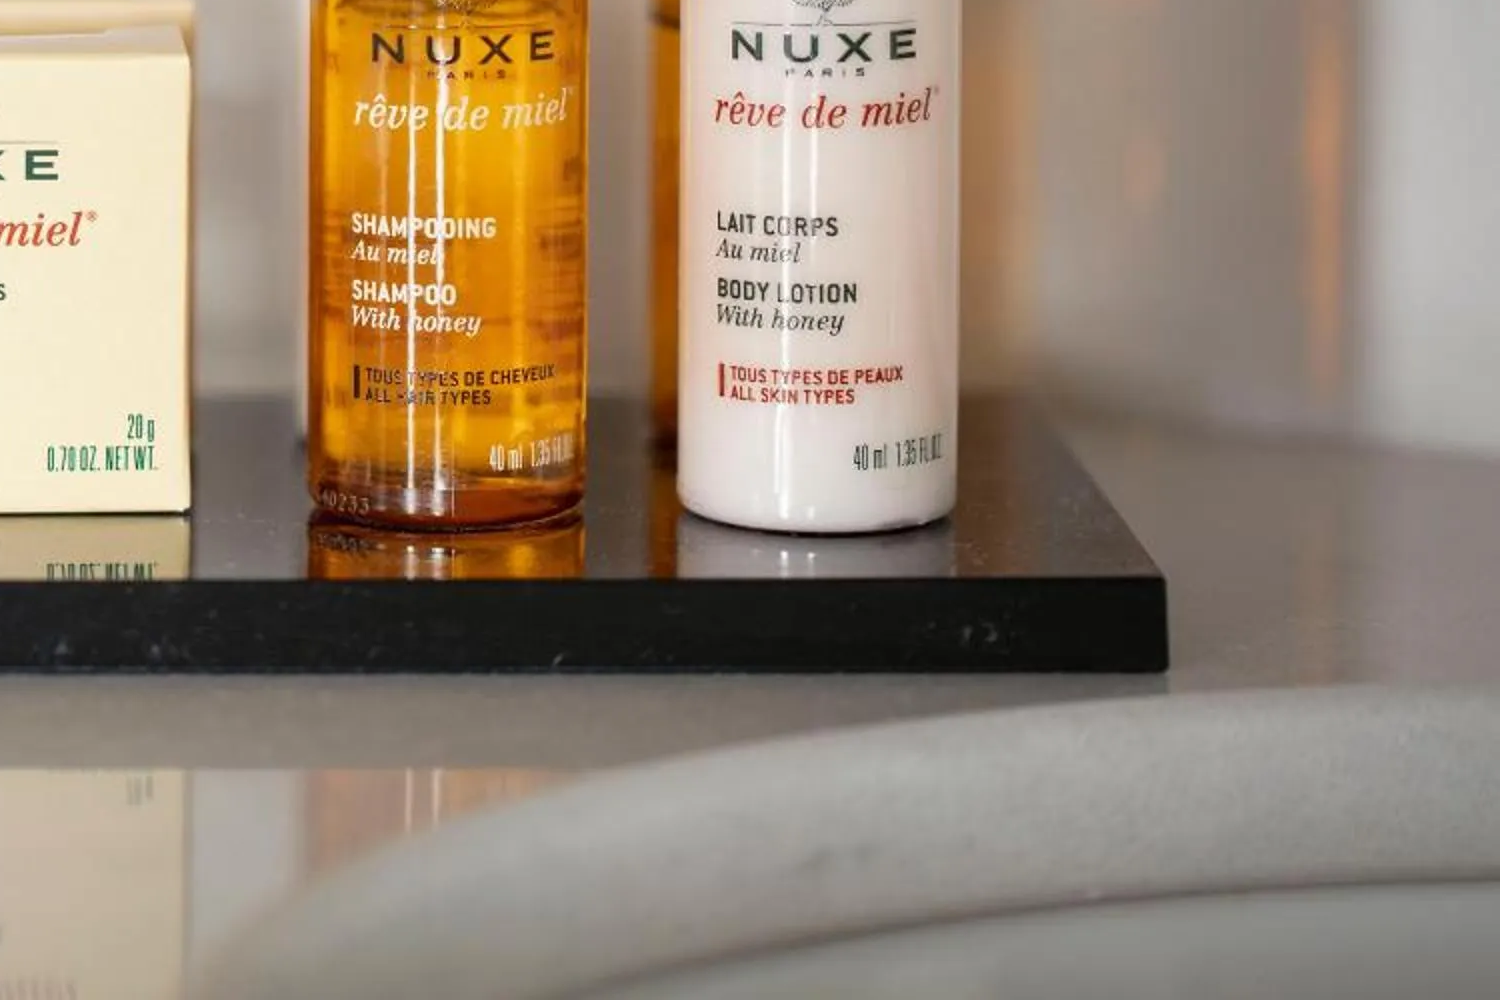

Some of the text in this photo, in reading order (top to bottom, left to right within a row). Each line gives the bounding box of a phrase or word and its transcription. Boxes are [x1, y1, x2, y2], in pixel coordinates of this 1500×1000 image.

[372, 30, 554, 65] NUXE
[731, 28, 917, 63] NUXE
[786, 68, 865, 77] PARIS
[354, 94, 428, 130] rêve
[444, 96, 490, 131] de
[715, 91, 786, 129] rêve
[801, 96, 847, 129] de
[351, 212, 497, 239] SHAMPOOING
[717, 210, 839, 237] LAIT CORPS
[350, 239, 440, 265] Au miel
[716, 238, 801, 263] Au miel
[352, 279, 457, 306] SHAMPOO
[717, 278, 857, 304] BODY LOTION
[351, 305, 481, 337] With honey
[716, 304, 845, 337] With honey
[366, 364, 555, 387] TOUS TYPES DE CHEVEUX
[730, 365, 904, 385] TOUS TYPES DE PEAUX
[366, 388, 391, 403] ALL
[440, 390, 491, 406] TYPES
[730, 385, 855, 405] ALL SKIN TYPES
[127, 413, 155, 443] 20 g
[47, 446, 76, 472] 0.70
[79, 446, 101, 471] OZ.
[105, 446, 130, 471] NET
[489, 444, 504, 471] 40
[507, 445, 524, 470] ml
[853, 443, 869, 471] 40
